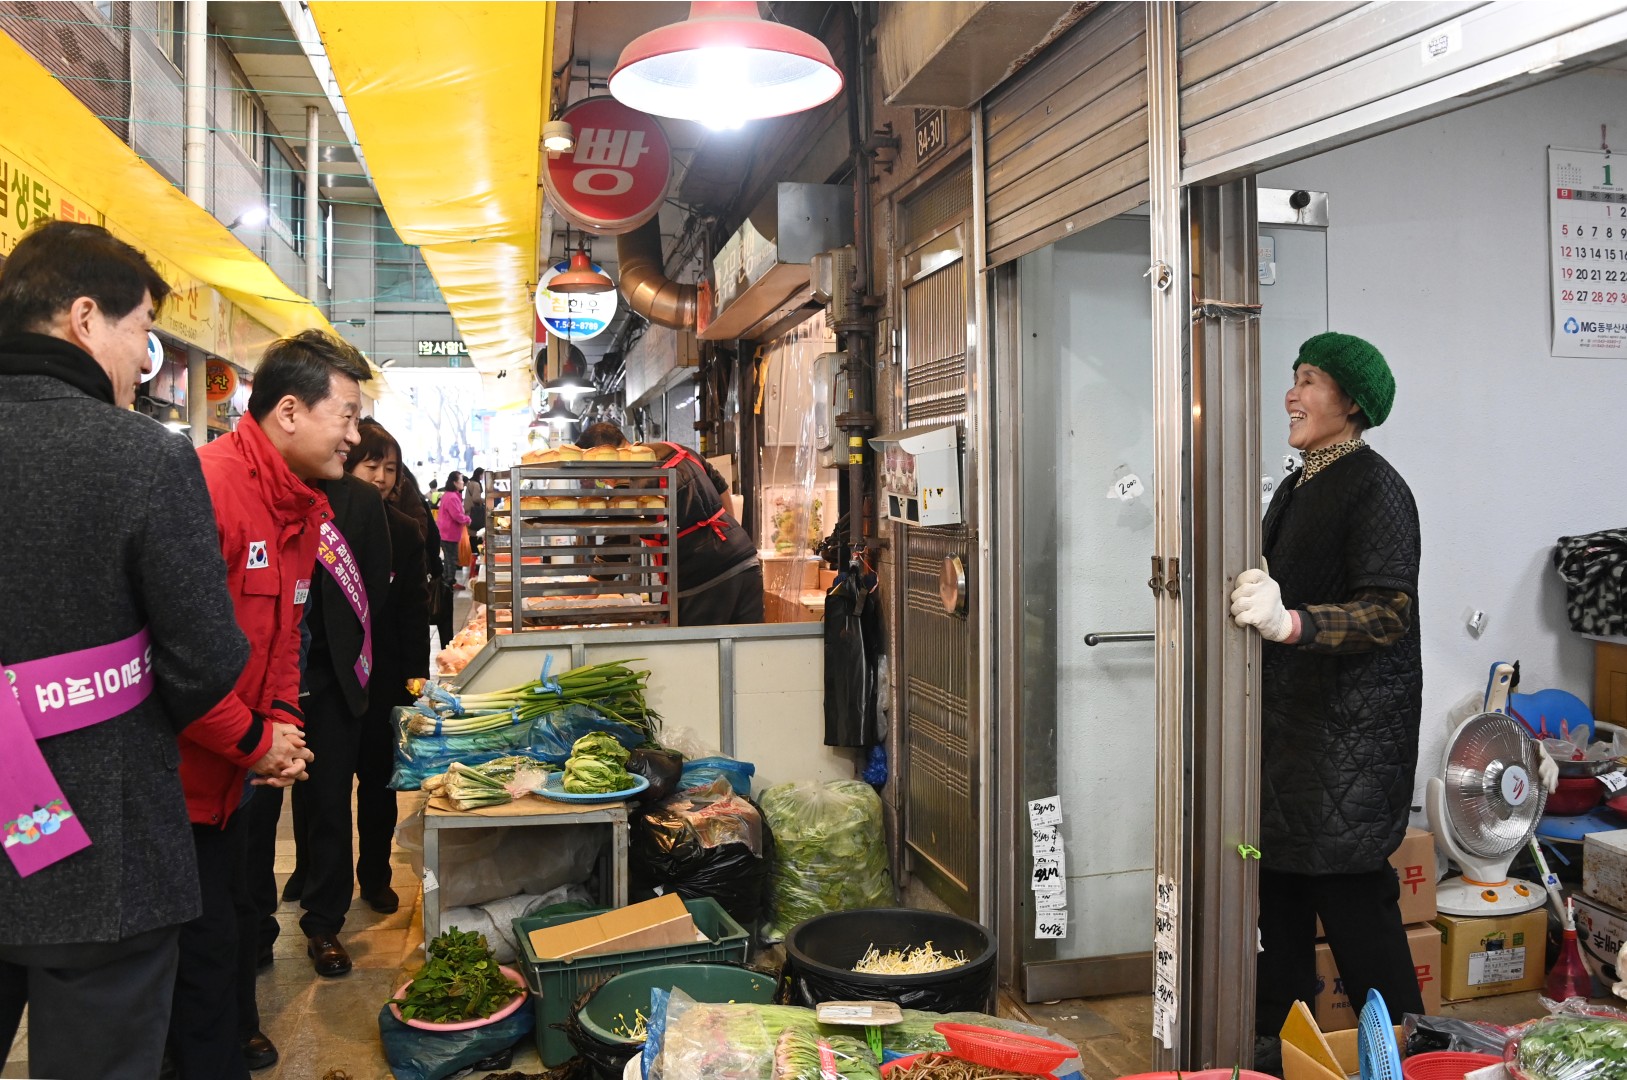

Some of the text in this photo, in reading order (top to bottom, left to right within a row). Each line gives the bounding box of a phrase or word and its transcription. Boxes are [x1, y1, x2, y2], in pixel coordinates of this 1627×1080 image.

[572, 128, 650, 196] 빵
[1602, 164, 1613, 186] 1
[1606, 205, 1627, 218] 1 2
[1562, 224, 1627, 239] 5 6 7 8 9
[1560, 246, 1572, 258] 12
[1575, 247, 1586, 258] 13
[1590, 248, 1601, 259] 14
[1605, 249, 1616, 260] 15
[1562, 268, 1627, 282] 19 20 21 22 2
[1562, 289, 1627, 304] 26 27 28 29 3
[35, 656, 142, 713] 받으세요
[1402, 865, 1427, 896] 무
